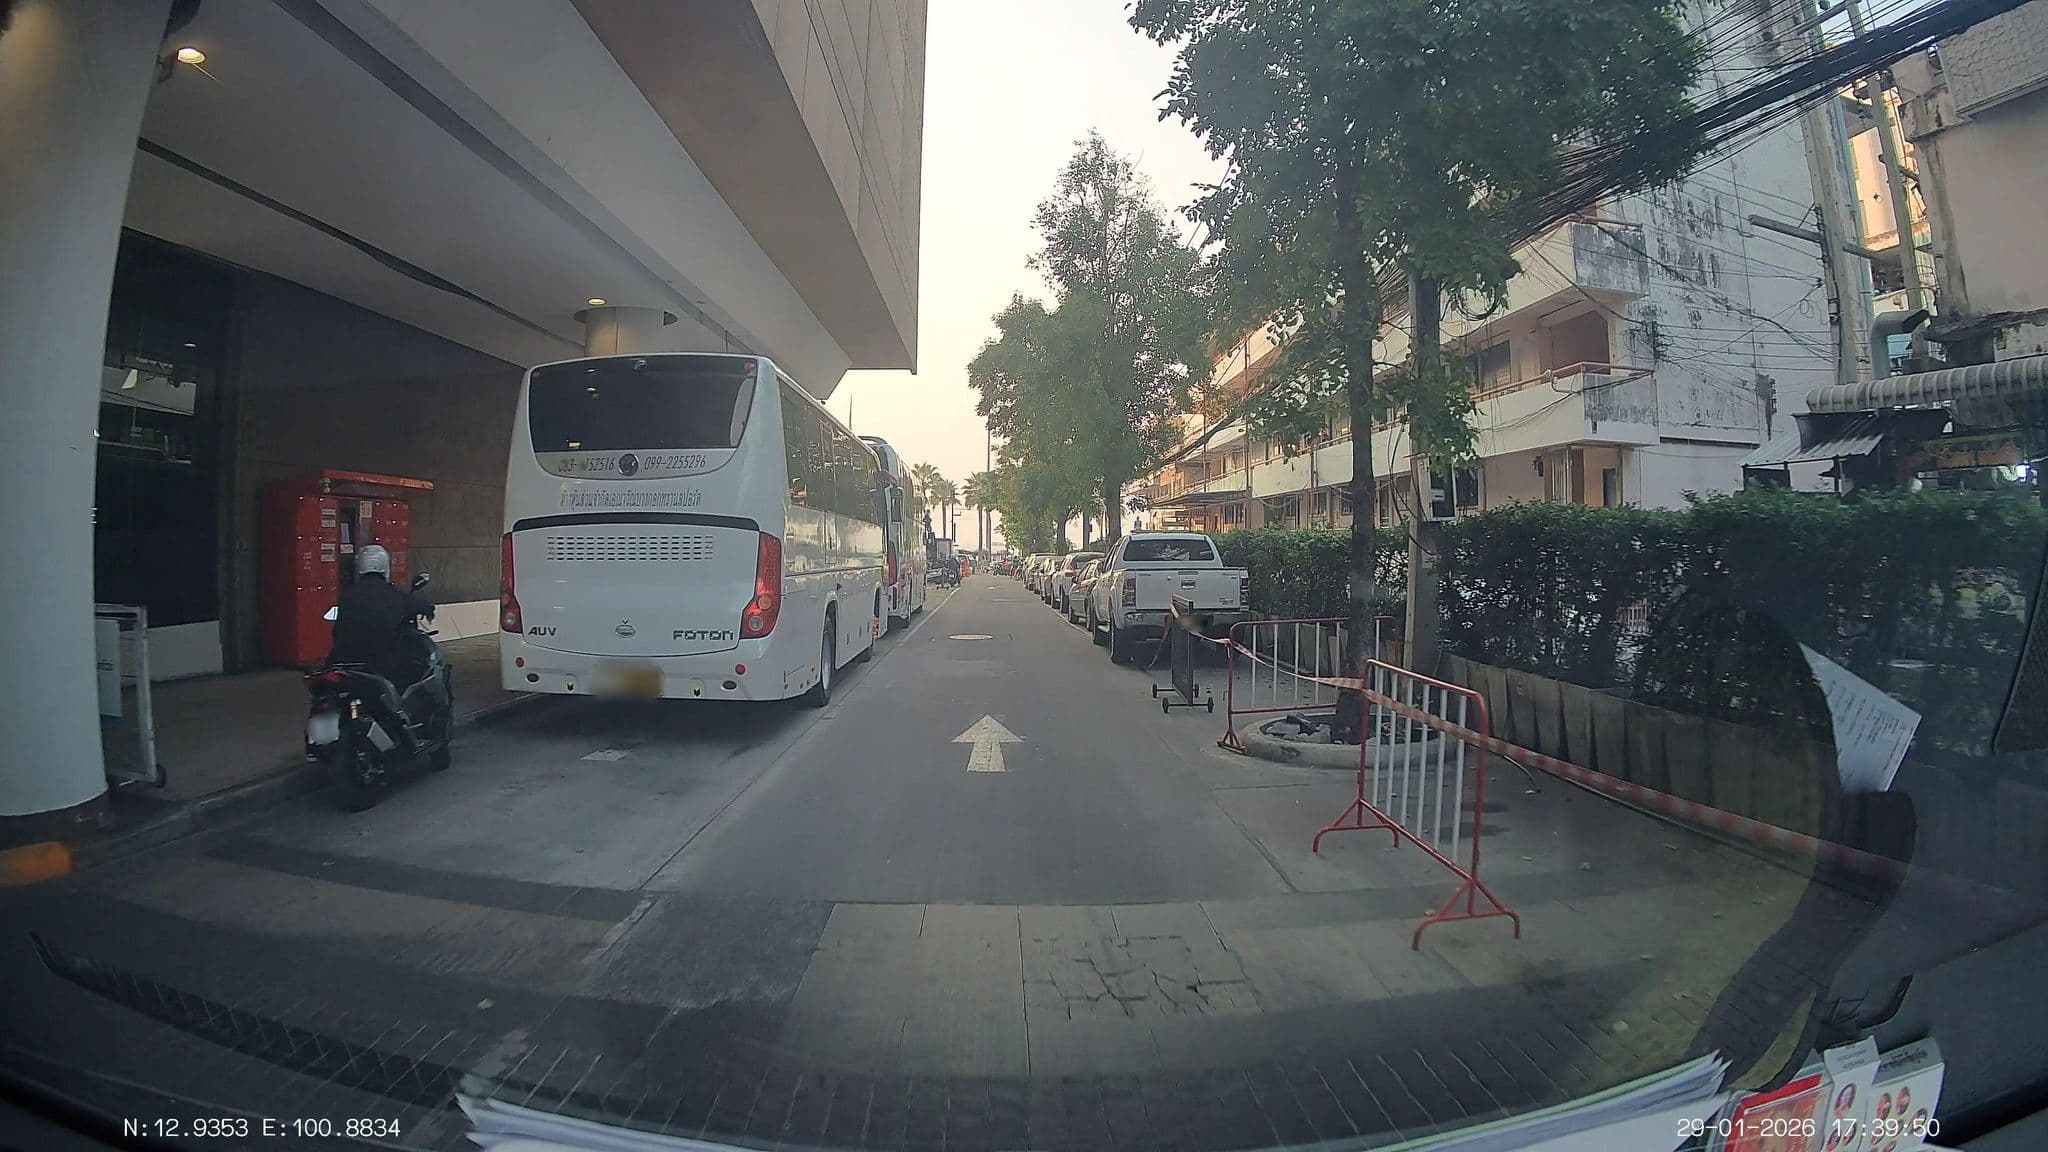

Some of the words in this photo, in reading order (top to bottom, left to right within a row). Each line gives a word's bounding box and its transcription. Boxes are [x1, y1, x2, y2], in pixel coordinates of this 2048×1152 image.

[644, 455, 706, 470] 099-2255296
[528, 626, 557, 636] AUV
[673, 630, 734, 641] FOTON
